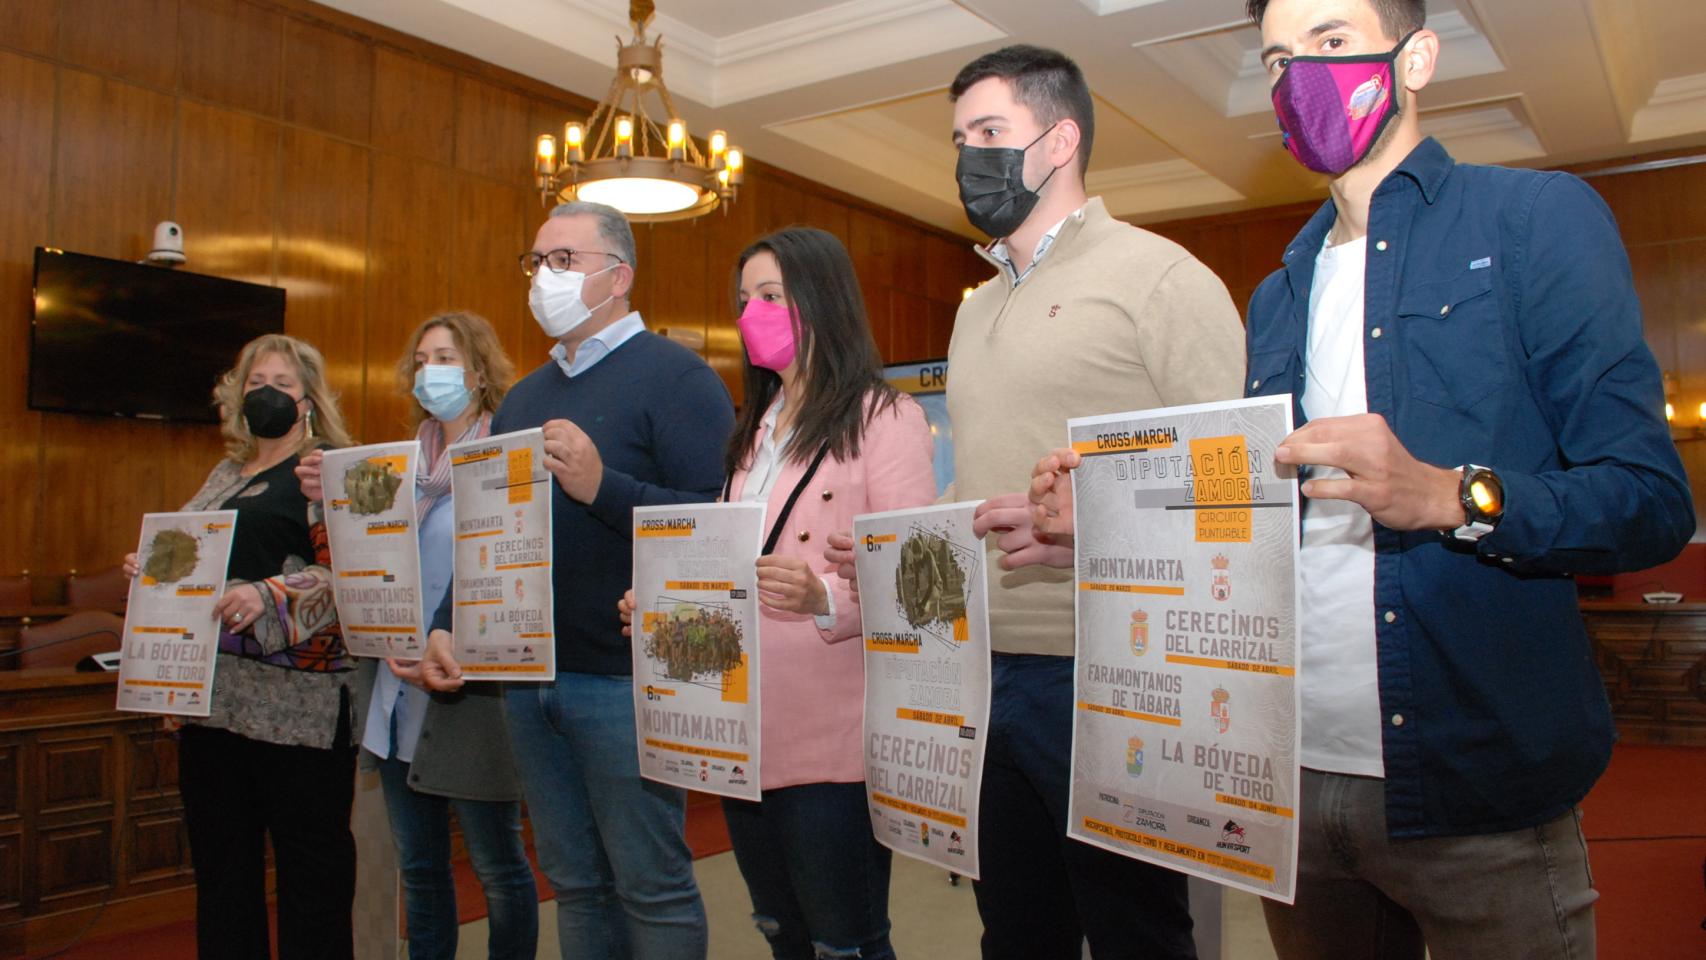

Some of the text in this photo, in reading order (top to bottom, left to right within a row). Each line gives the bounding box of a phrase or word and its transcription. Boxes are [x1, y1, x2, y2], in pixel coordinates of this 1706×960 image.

[1097, 427, 1178, 449] CROSS/MARCHA
[1115, 446, 1262, 481] DIPUTACIÓN
[1184, 477, 1264, 502] ZAMORA
[460, 515, 503, 530] MONTAMARTA
[642, 518, 696, 531] CROSS/MARCHA
[1199, 511, 1248, 523] CIRCUITO
[866, 534, 874, 552] 6
[1199, 528, 1247, 539] PUNTUABLE
[494, 554, 508, 565] DEL
[1089, 558, 1184, 581] MONTAMARTA
[341, 587, 415, 604] FARAMONTANOS
[362, 608, 376, 624] DE
[494, 608, 544, 623] LA BÓVEDA
[1166, 610, 1280, 639] CERECINOS
[512, 622, 544, 633] DE TORO
[872, 632, 922, 646] CROSS/MARCHA
[1166, 634, 1278, 662] DEL CARRIZAL
[128, 638, 208, 662] LA BÓVEDA
[157, 665, 206, 680] DE TORO
[1088, 664, 1182, 694] FARAMONTANOS
[647, 685, 654, 700] 6
[1112, 689, 1181, 717] DE TÁBARA
[642, 708, 748, 746] MONTAMARTA
[870, 732, 972, 779] CERECINOS
[1162, 738, 1274, 781] LA BÓVEDA
[870, 766, 892, 793] DEL
[897, 773, 966, 813] CARRIZAL
[1204, 771, 1274, 802] DE TORO
[1136, 817, 1167, 832] ZAMORA
